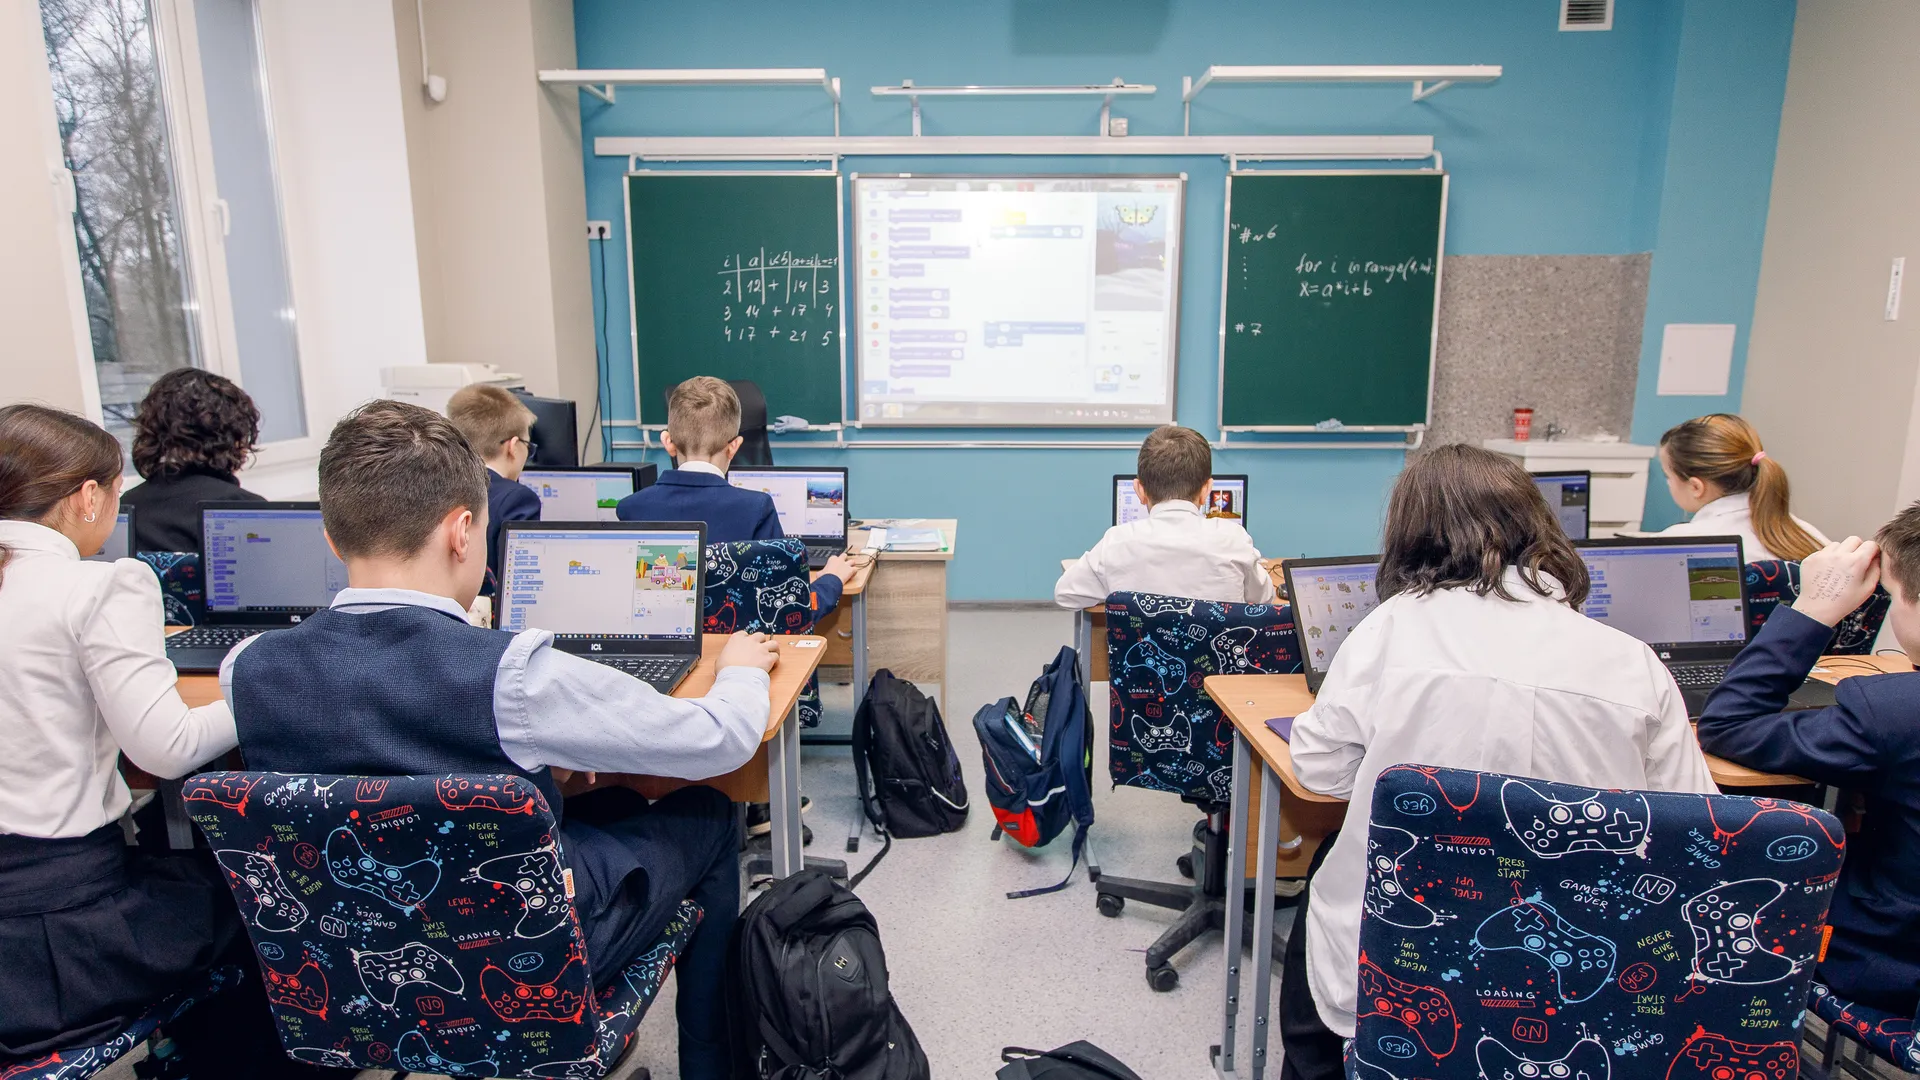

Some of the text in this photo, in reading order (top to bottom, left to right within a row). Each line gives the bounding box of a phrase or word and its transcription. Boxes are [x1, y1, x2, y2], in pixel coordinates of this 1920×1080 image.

[724, 255, 730, 267] i
[749, 257, 759, 266] a
[1295, 253, 1322, 274] for
[1331, 255, 1338, 273] i
[723, 280, 732, 295] 2
[747, 279, 761, 293] 12
[793, 280, 808, 293] 14
[818, 280, 829, 294] 3
[724, 306, 732, 321] 3
[745, 305, 760, 318] 14
[791, 304, 807, 316] 17
[825, 303, 834, 318] 4
[724, 325, 732, 342] 4
[739, 326, 756, 341] 17
[789, 330, 807, 342] 21
[821, 331, 833, 347] 5
[743, 571, 757, 579] NO
[1191, 628, 1205, 638] NO
[590, 643, 602, 651] ICL
[1188, 764, 1203, 773] NO
[360, 780, 384, 796] NO
[280, 784, 306, 806] OVER
[1402, 798, 1430, 812] YES
[272, 825, 294, 833] PRESS
[370, 814, 420, 831] LOADING
[468, 823, 500, 831] NEVER
[278, 833, 300, 843] START
[478, 832, 496, 840] GIVE
[1688, 827, 1719, 852] OVER
[485, 840, 499, 848] UP!
[1435, 843, 1495, 856] LOADING
[1777, 841, 1809, 856] YES
[1498, 857, 1526, 868] PRESS
[1685, 844, 1721, 869] GAME
[1497, 868, 1529, 880] START
[1451, 887, 1483, 900] LEVEL
[1559, 879, 1601, 896] GAME
[1638, 880, 1670, 896] NO
[448, 897, 475, 907] LEVEL
[1573, 894, 1609, 909] OVER
[458, 907, 475, 916] UP!
[323, 921, 343, 935] NO
[367, 919, 397, 930] GAME
[422, 922, 445, 932] START
[452, 930, 501, 943] LOADING
[1637, 930, 1675, 948] NEVER
[302, 940, 331, 960] GAME
[1400, 938, 1415, 950] UP!
[1652, 942, 1674, 956] GIVE
[263, 945, 279, 957] YES
[1400, 949, 1420, 960] GIVE
[1663, 950, 1681, 962] UP!
[513, 955, 536, 970] YES
[1394, 956, 1428, 972] NEVER
[1623, 967, 1649, 990] YES
[1476, 988, 1536, 999] LOADING
[1633, 994, 1666, 1004] START
[421, 999, 442, 1012] NO
[1750, 995, 1767, 1007] UP!
[1637, 1006, 1666, 1015] PRESS
[1749, 1008, 1771, 1017] GIVE
[1741, 1018, 1779, 1028] NEVER
[438, 1025, 482, 1036] LOADING
[1516, 1023, 1543, 1040] NO
[1612, 1030, 1643, 1048] OVER
[1386, 1041, 1411, 1056] YES
